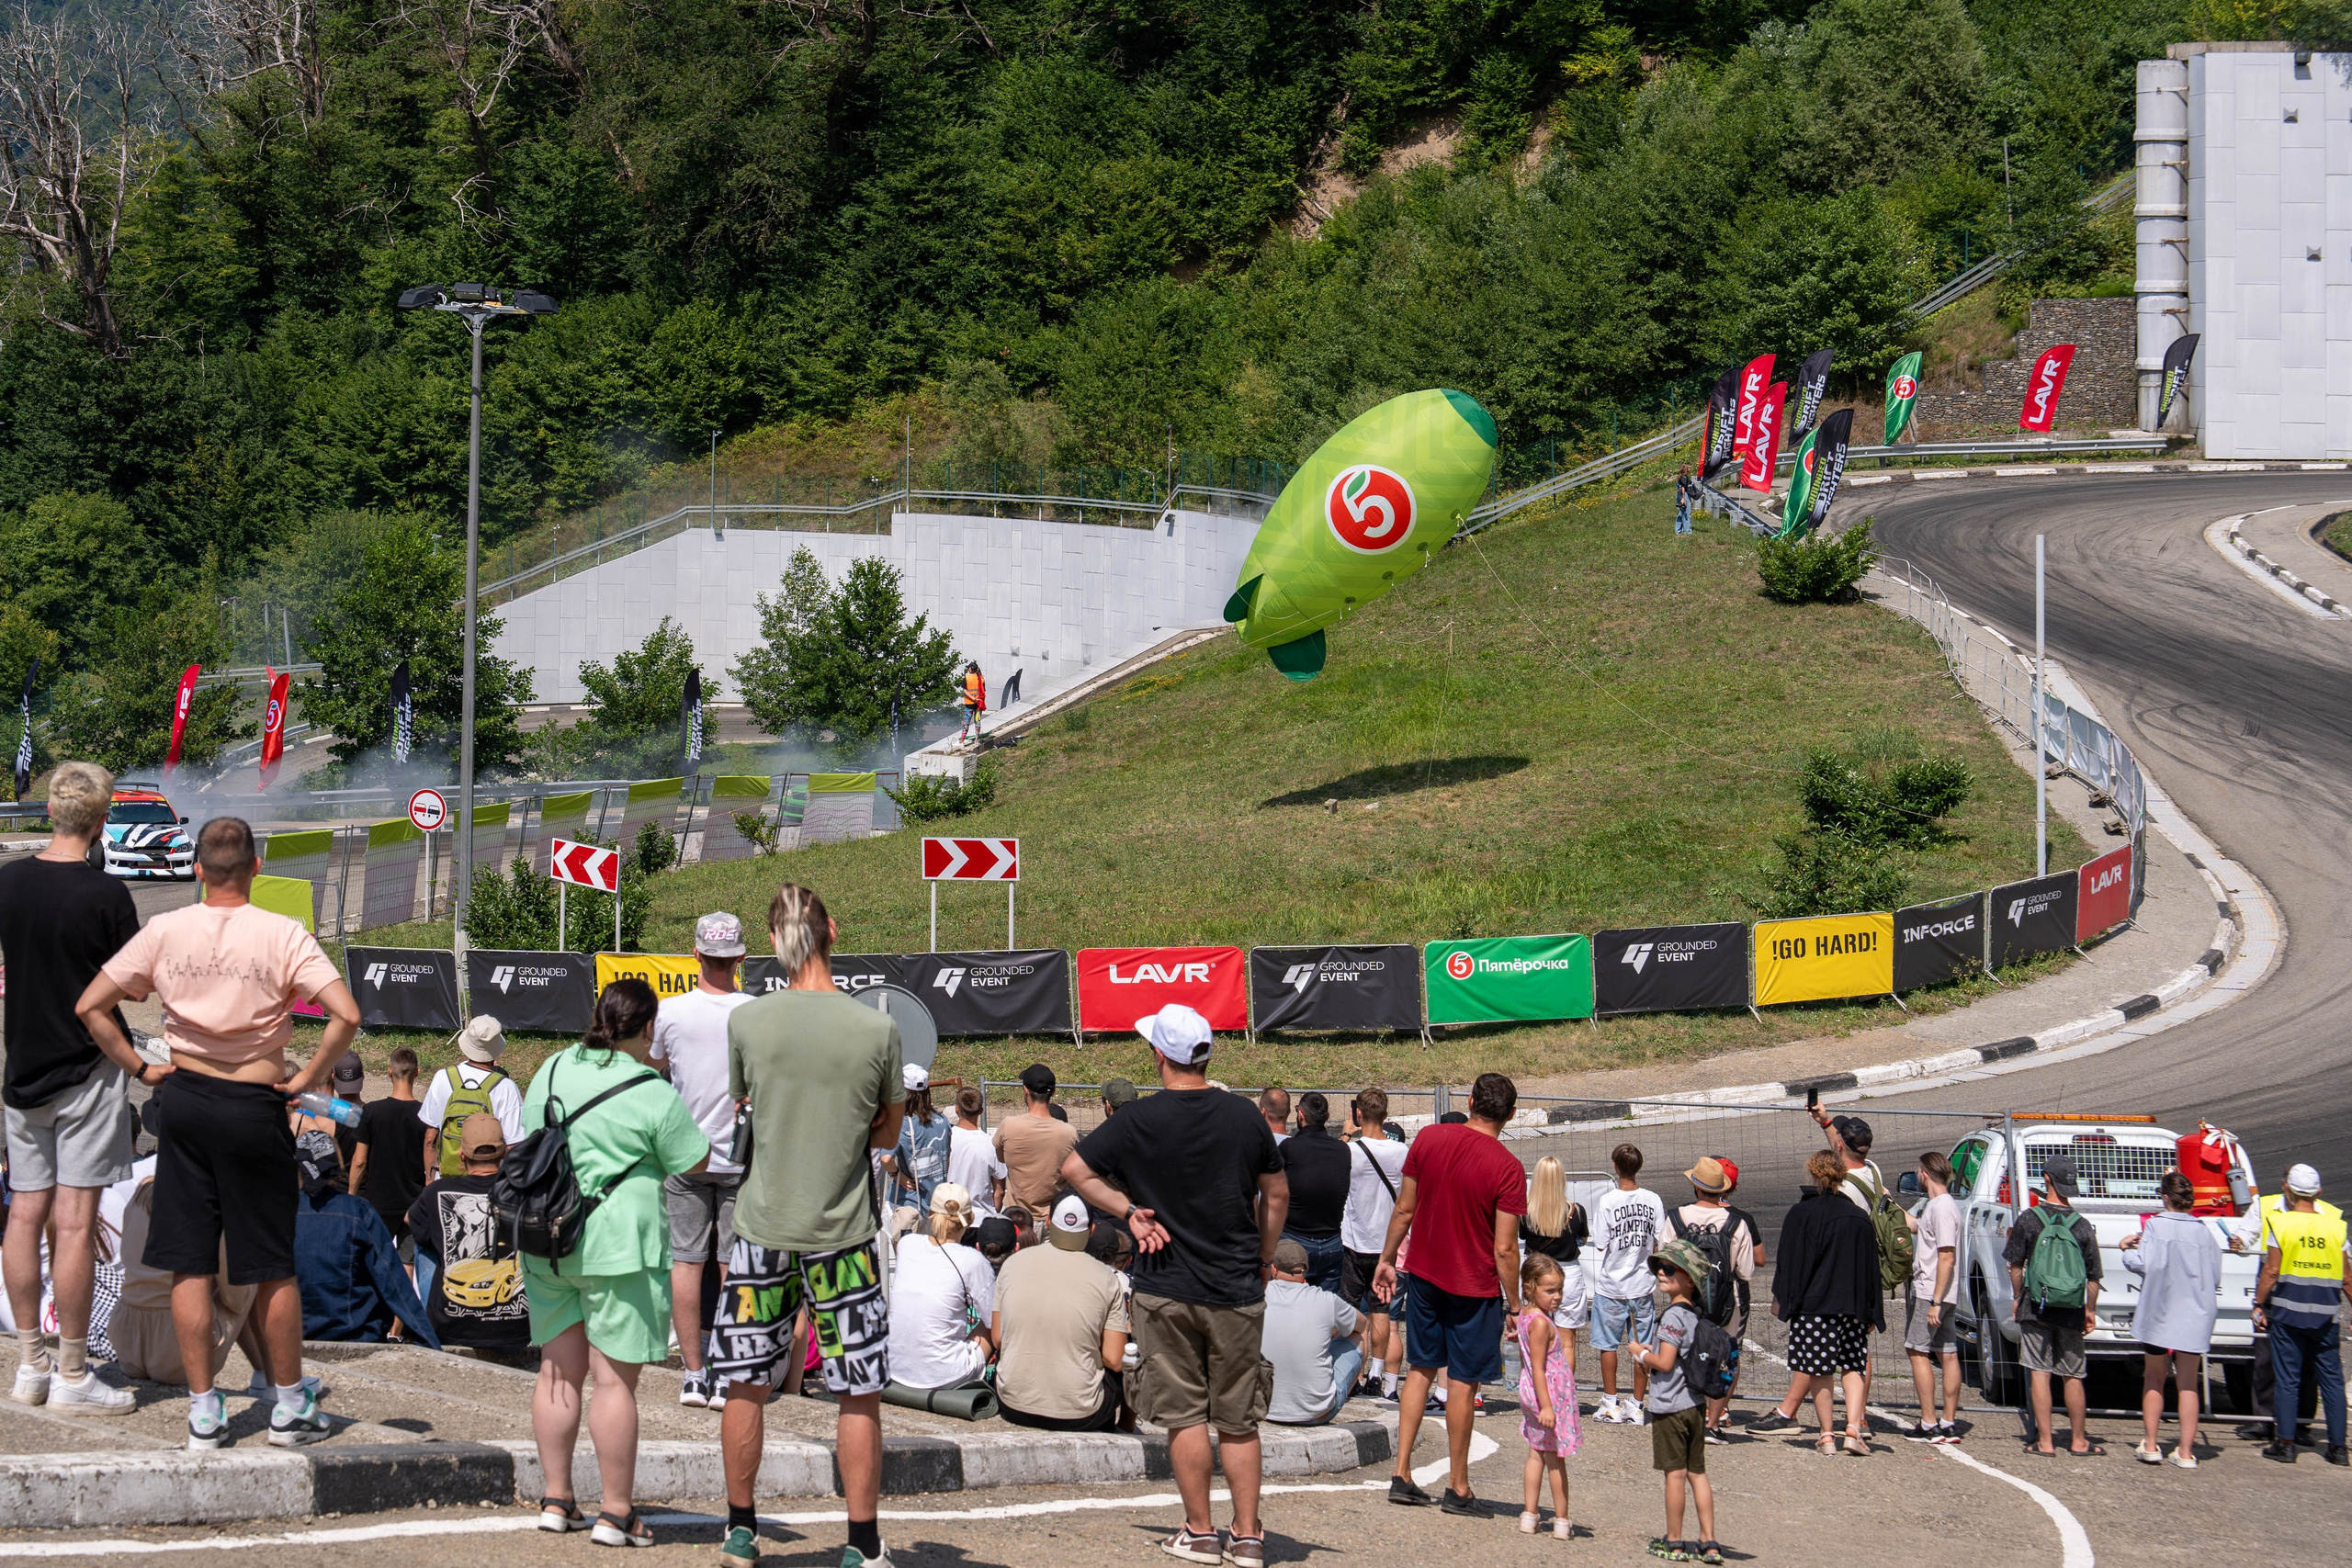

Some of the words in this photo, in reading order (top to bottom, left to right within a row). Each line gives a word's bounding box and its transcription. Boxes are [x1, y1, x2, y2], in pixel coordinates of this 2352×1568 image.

[1794, 381, 1815, 435] DRIFT
[1804, 374, 1826, 432] FIGHTERS
[1722, 398, 1737, 459] FIGHTERS
[1710, 407, 1731, 467] DRIFT
[2027, 890, 2062, 906] GROUNDED
[2028, 903, 2049, 915] EVENT
[703, 928, 738, 942] RDS
[1904, 915, 1975, 943] INFORCE
[1657, 940, 1718, 952] GROUNDED
[1772, 938, 1806, 961] !GO
[1815, 931, 1877, 956] HARD!
[1657, 951, 1696, 963] EVENT
[390, 964, 434, 976] GROUNDED
[518, 967, 567, 978] GROUNDED
[970, 964, 1035, 976] GROUNDED
[1319, 961, 1385, 973] GROUNDED
[1478, 958, 1568, 975] Пятёрочка
[390, 974, 418, 983] EVENT
[519, 976, 550, 987] EVENT
[971, 976, 1011, 987] EVENT
[1320, 971, 1361, 982] EVENT
[764, 975, 886, 993] INRCE
[1613, 1203, 1655, 1223] COLLEGE
[2299, 1236, 2325, 1249] 188
[2292, 1260, 2332, 1269] STEWARD
